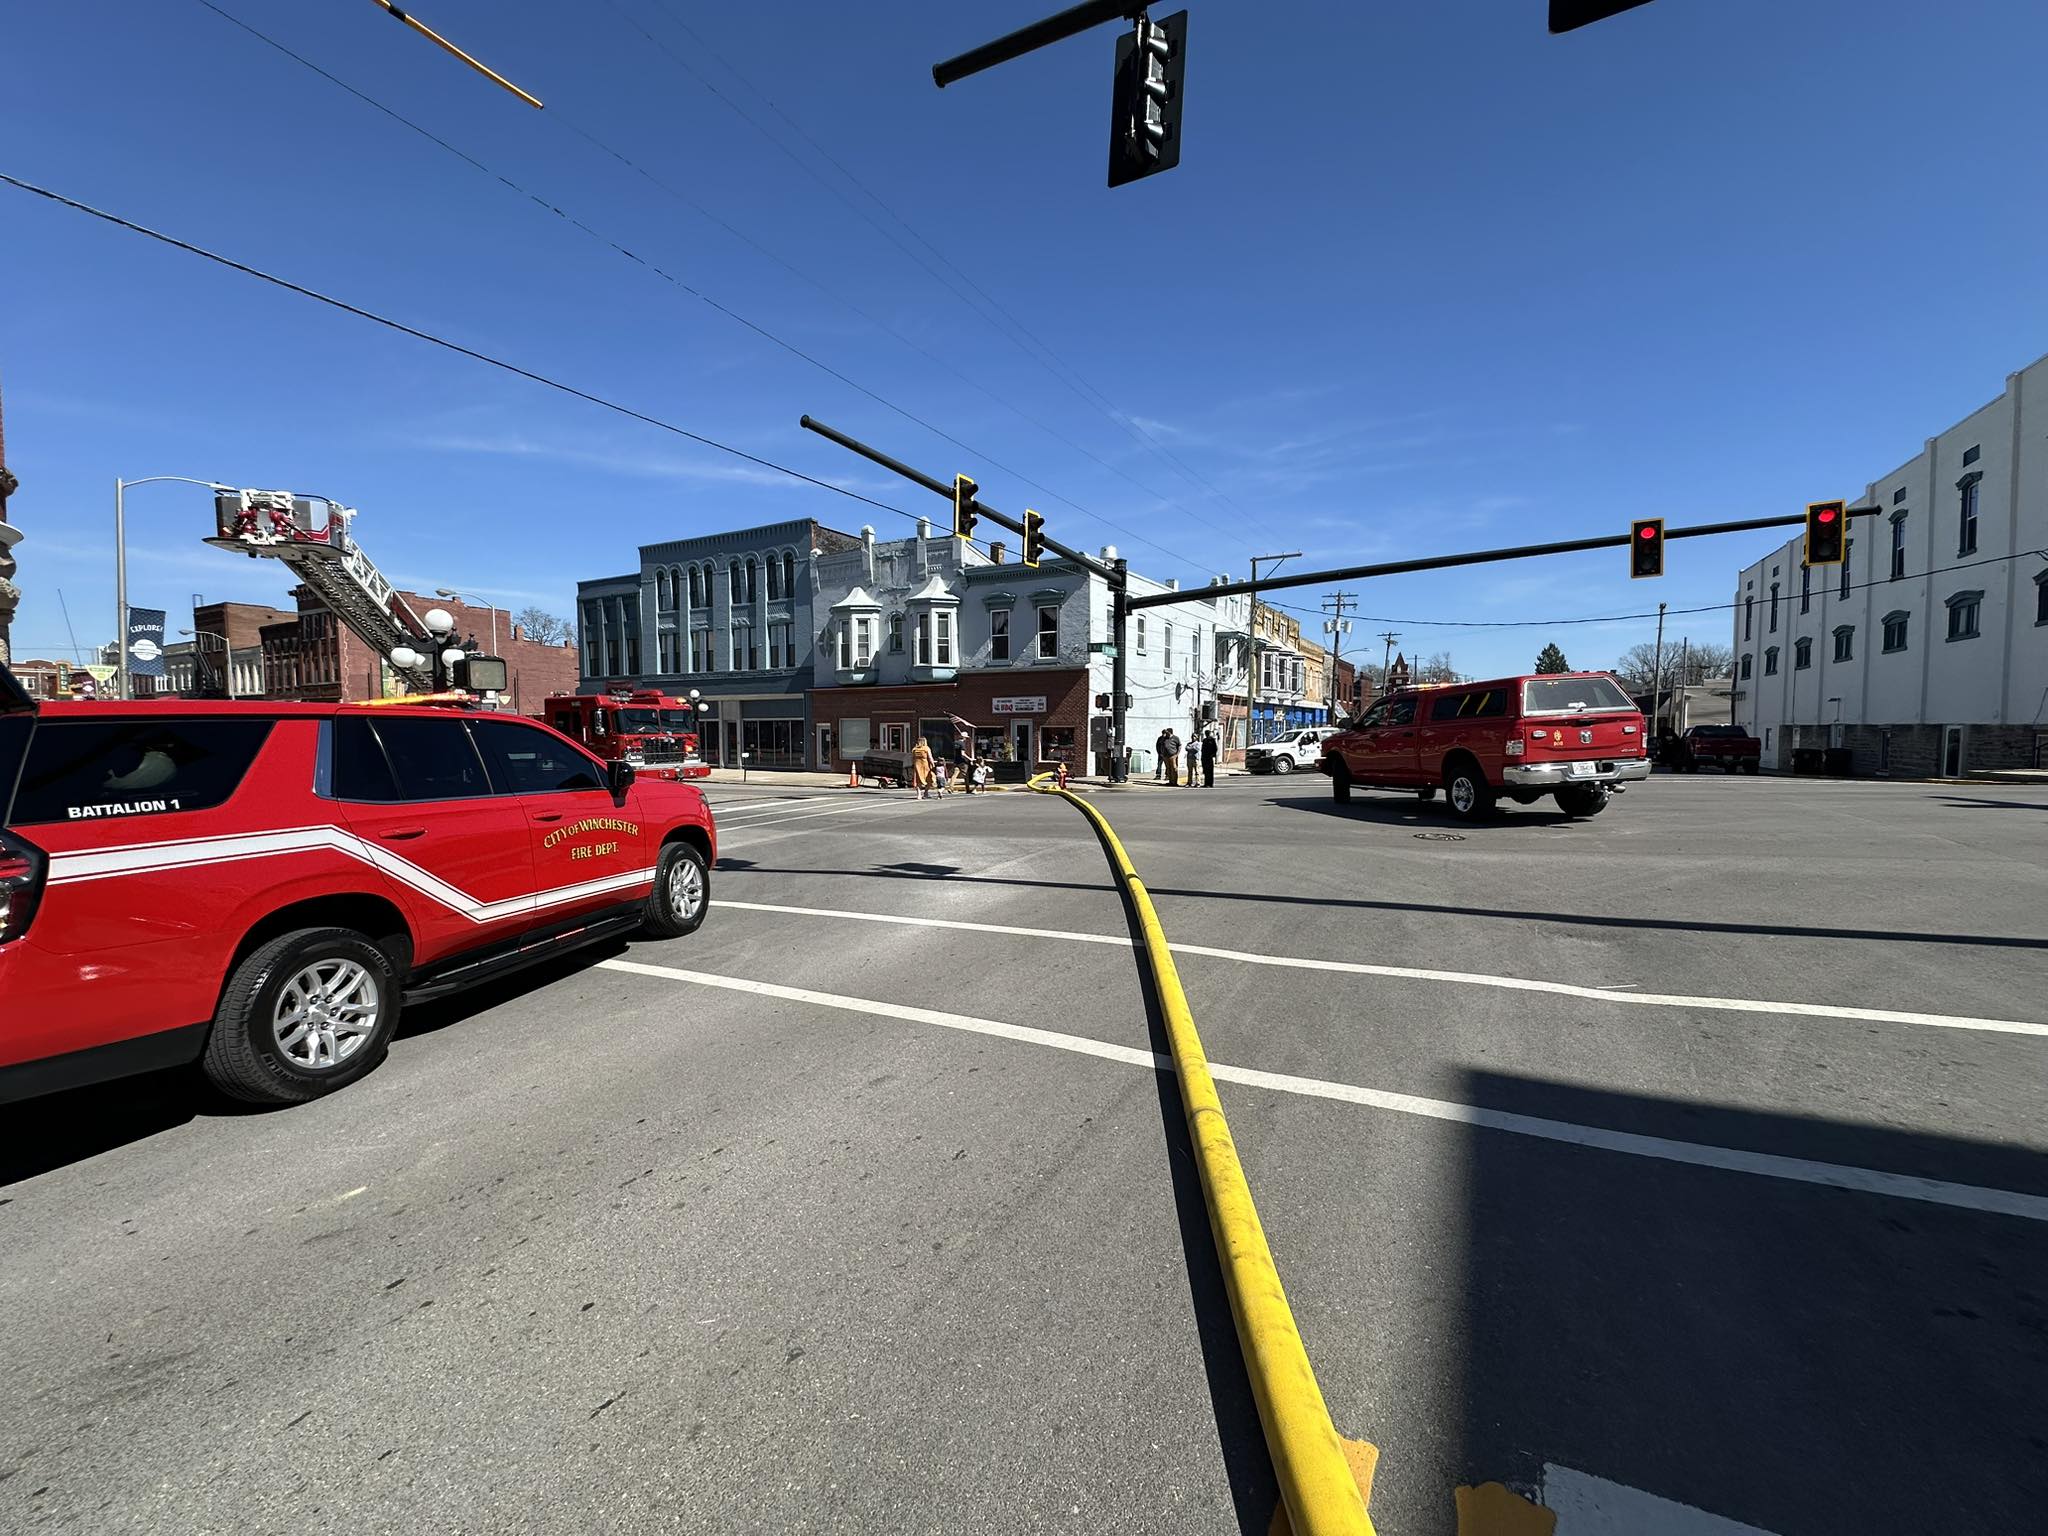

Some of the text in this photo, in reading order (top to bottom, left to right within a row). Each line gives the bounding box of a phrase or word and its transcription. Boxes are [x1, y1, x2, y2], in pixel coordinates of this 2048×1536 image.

[68, 799, 180, 818] BATTALION 1
[544, 817, 639, 848] CITY OF WINCHESTER
[571, 841, 619, 860] FIRE DEPT.
